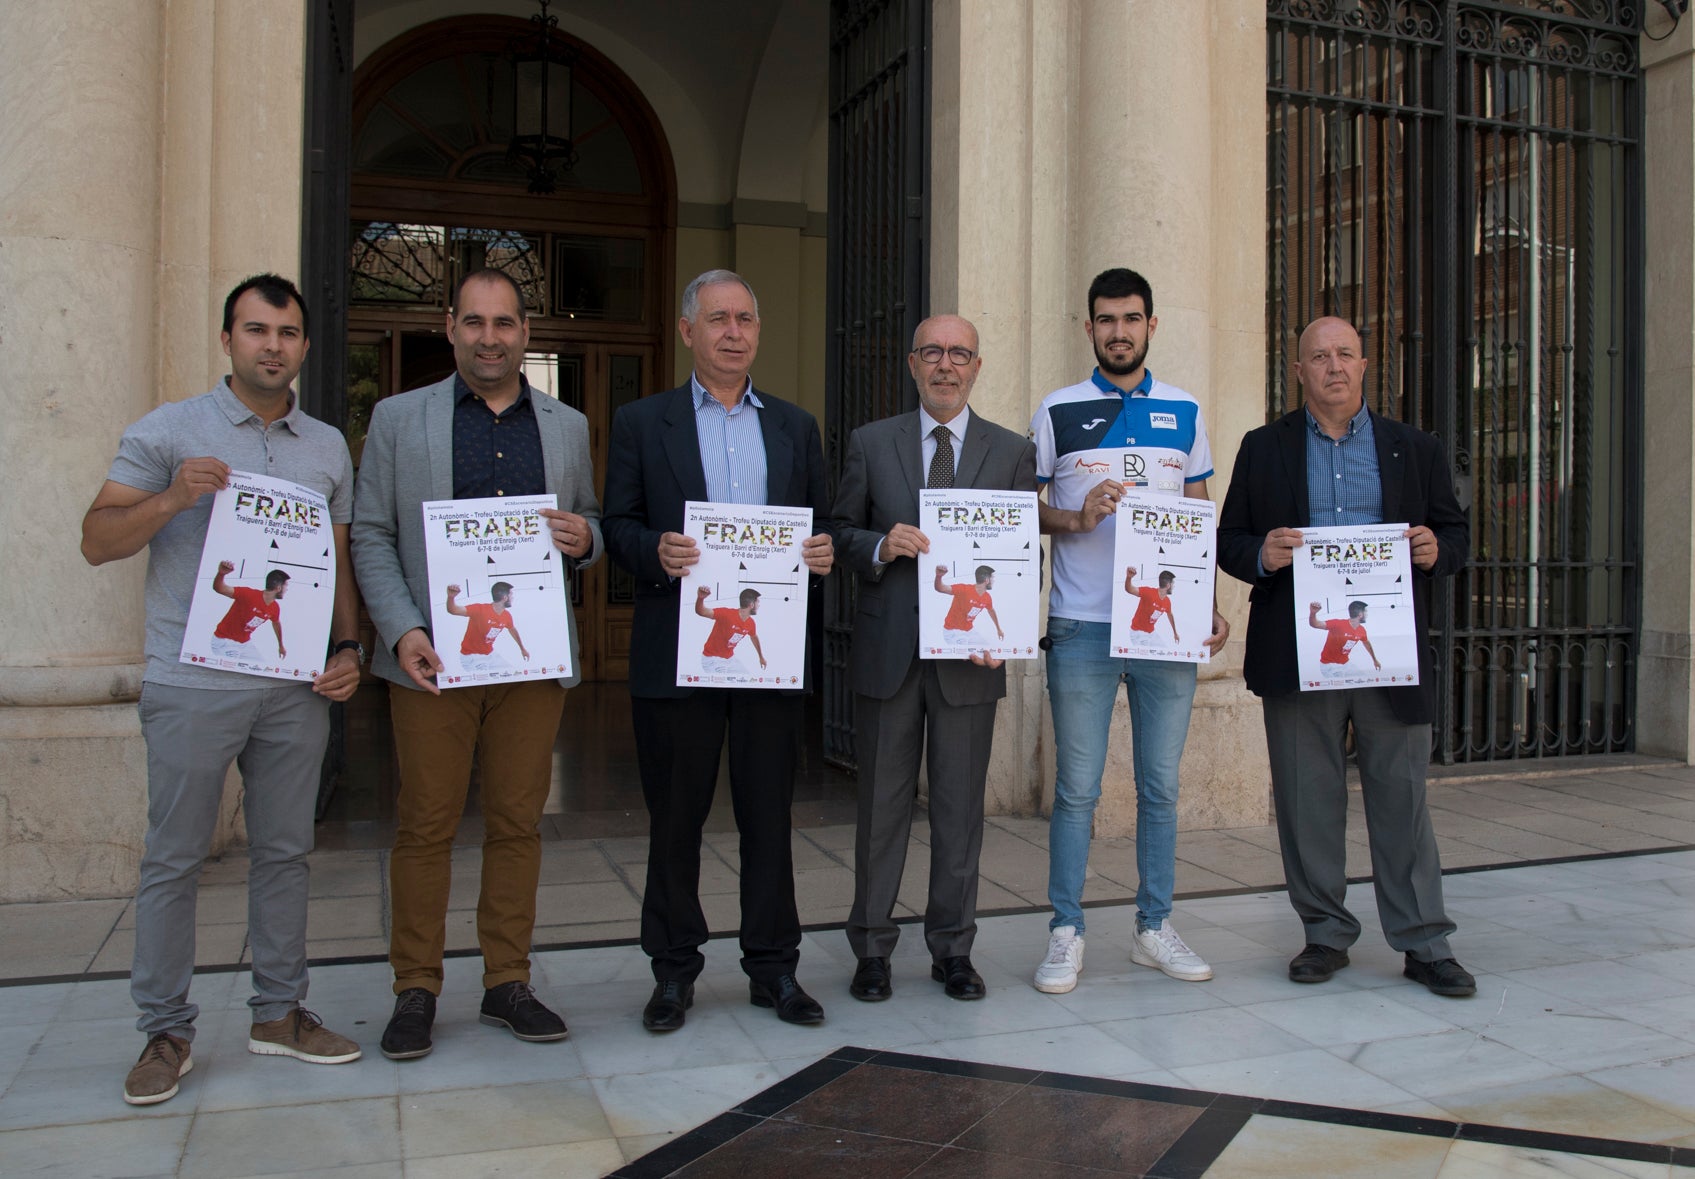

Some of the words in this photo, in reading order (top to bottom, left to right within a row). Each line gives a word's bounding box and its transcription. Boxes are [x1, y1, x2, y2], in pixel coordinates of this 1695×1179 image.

[236, 492, 321, 528] FRARE
[938, 508, 1021, 525] FRARE
[446, 516, 540, 538] FRARE
[1132, 510, 1202, 534] FRARE
[704, 523, 793, 546] FRARE
[1311, 543, 1393, 561] FRARE
